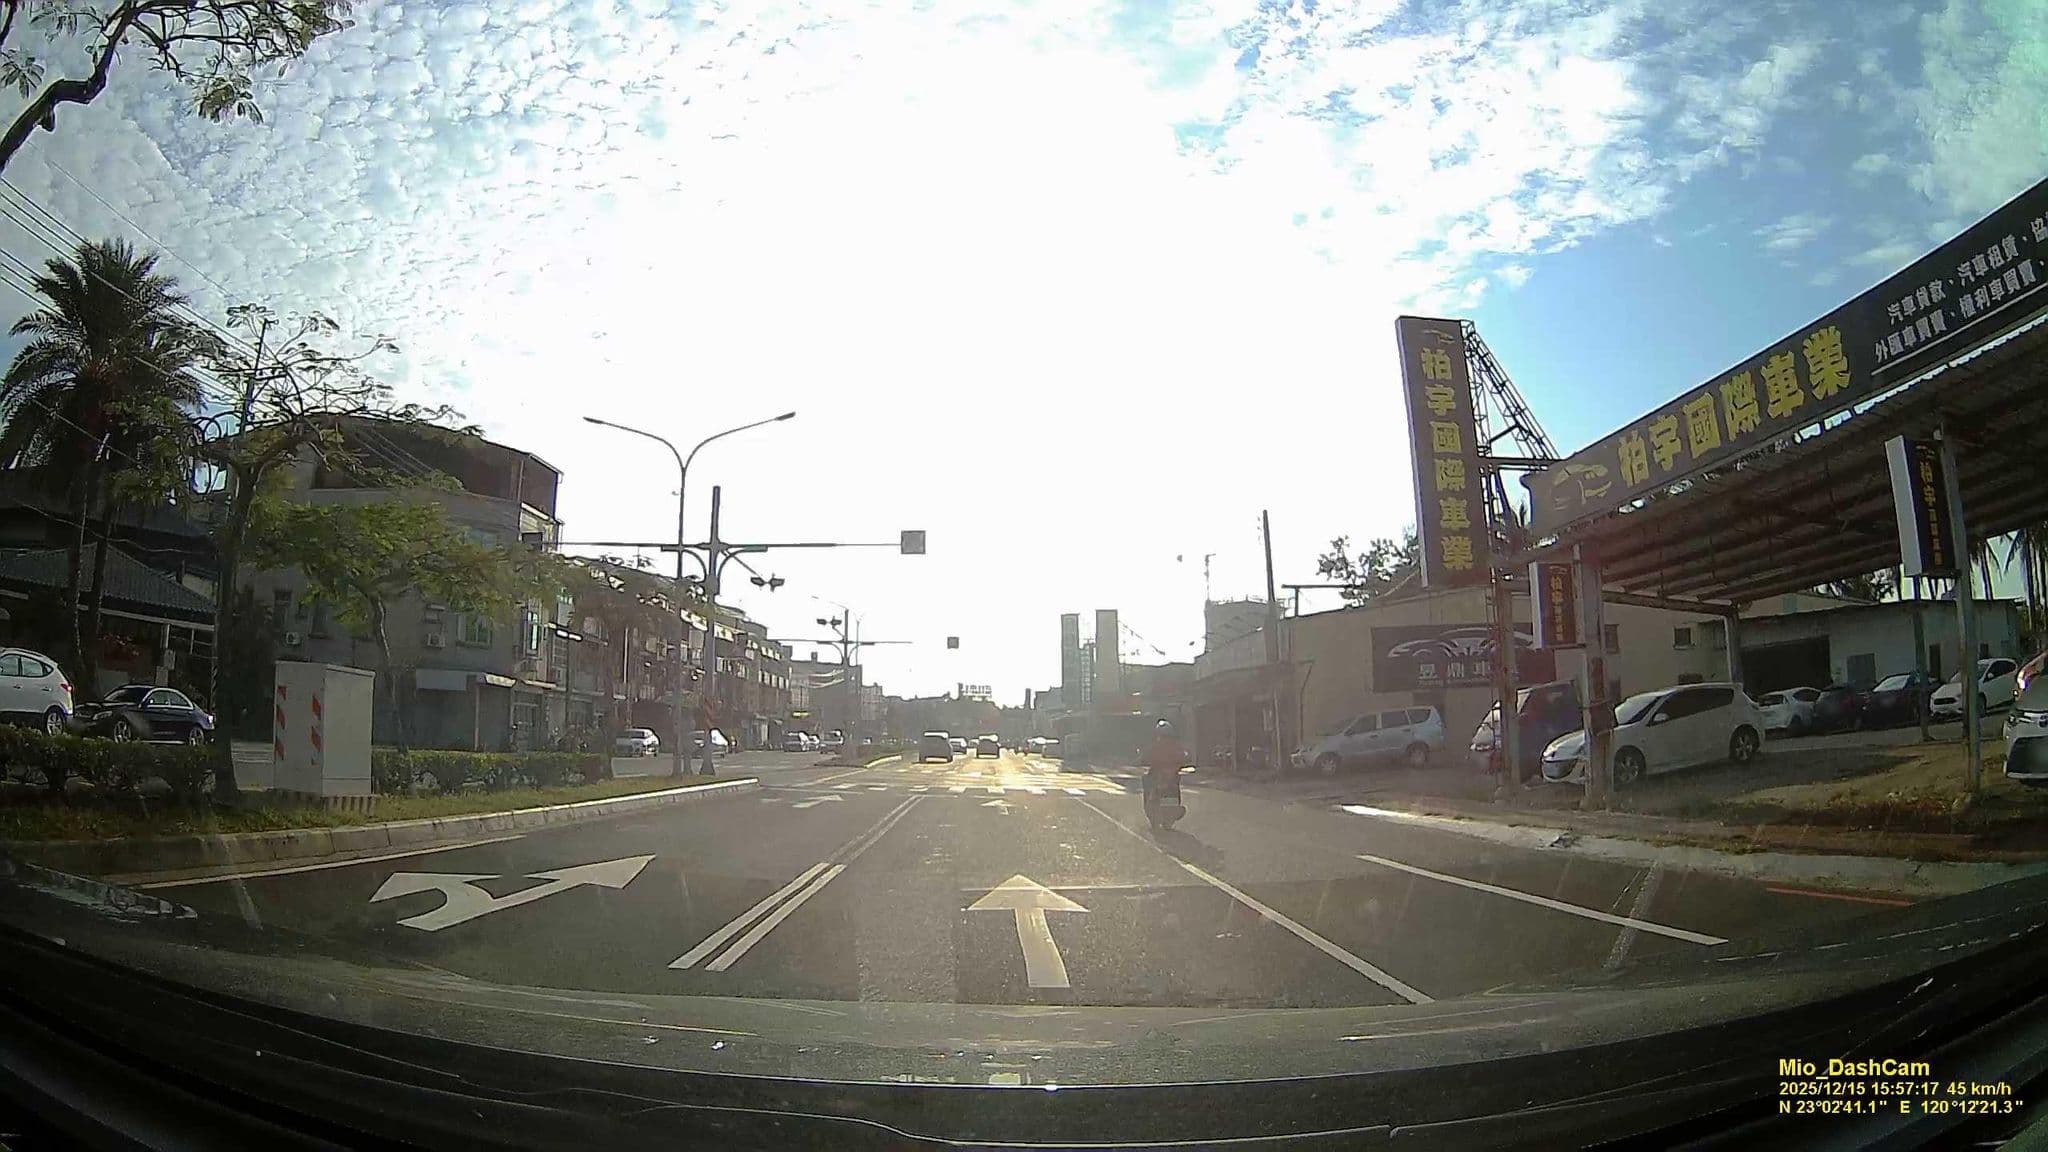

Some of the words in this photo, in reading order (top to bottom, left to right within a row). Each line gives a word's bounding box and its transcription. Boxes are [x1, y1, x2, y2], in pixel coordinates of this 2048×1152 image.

[1420, 347, 1474, 570] 柏宇國際車業
[1617, 325, 1850, 488] 柏宇國際車業
